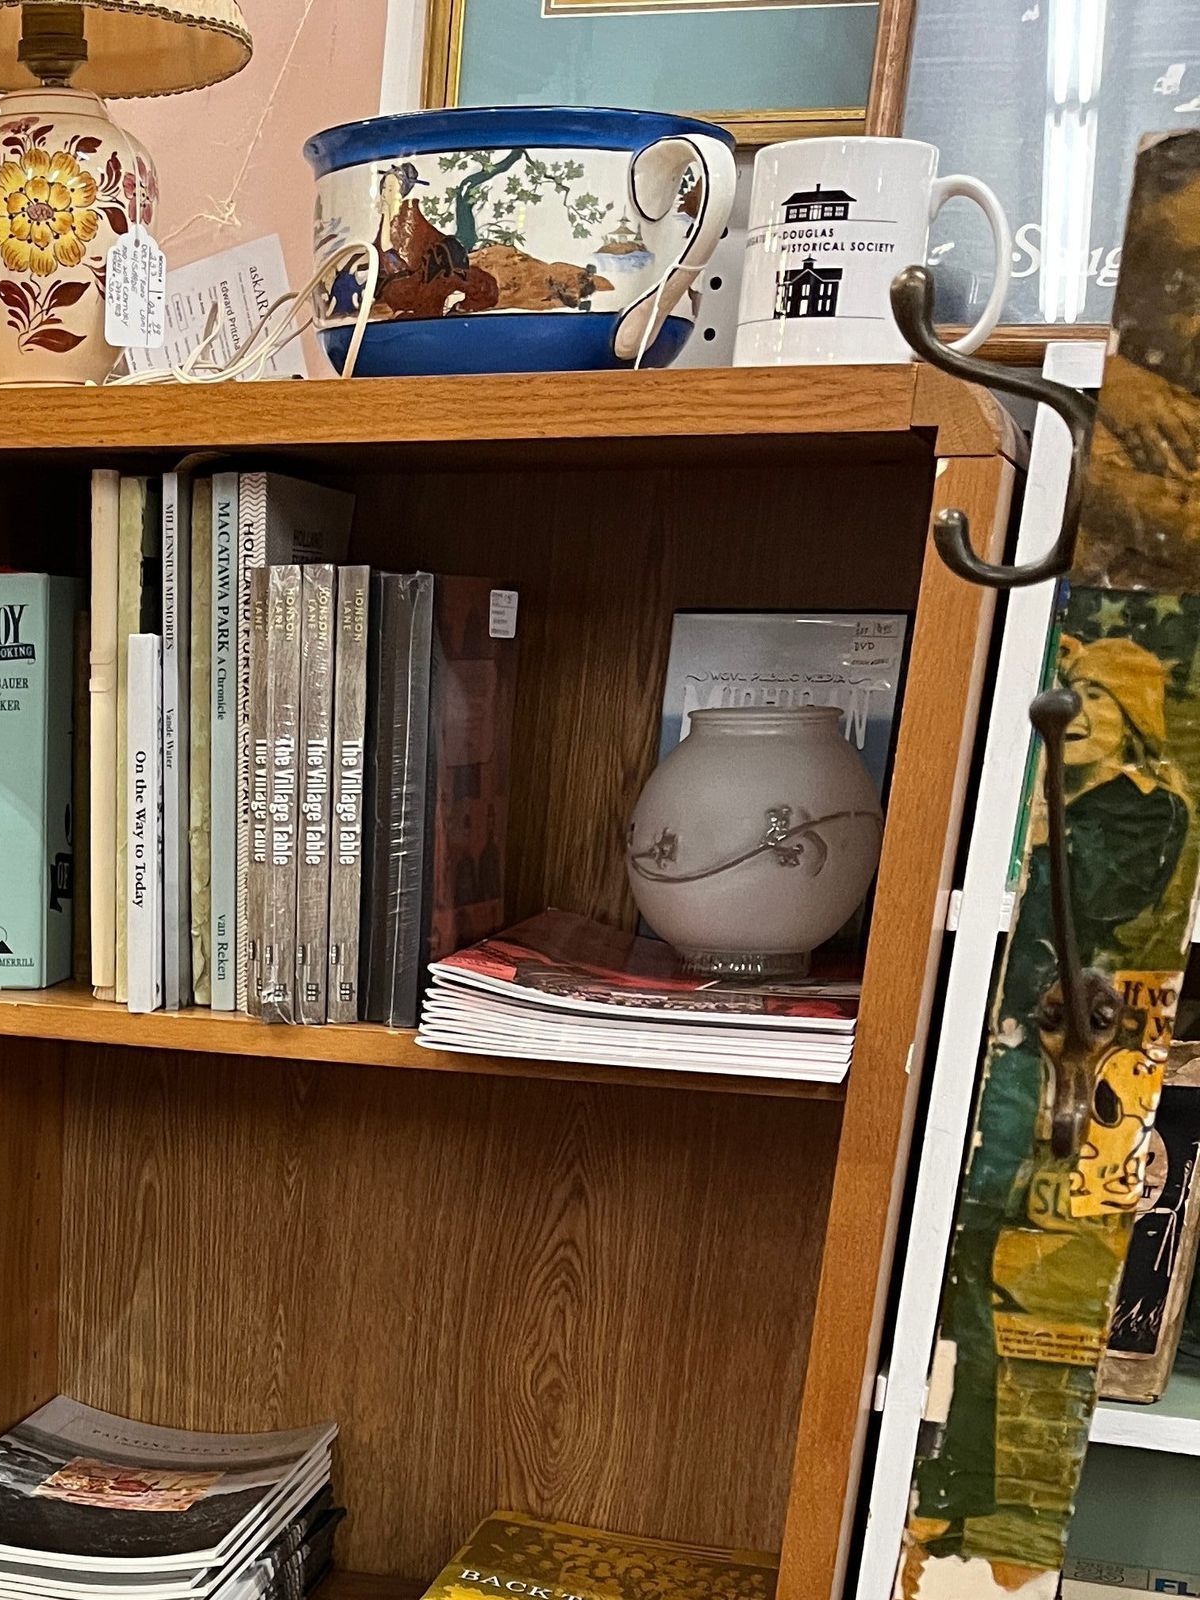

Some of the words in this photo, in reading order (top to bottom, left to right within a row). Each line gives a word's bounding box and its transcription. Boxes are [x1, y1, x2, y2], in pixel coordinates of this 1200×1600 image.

[781, 242, 846, 254] HISTORICAL
[850, 242, 895, 253] SOCIETY
[220, 280, 233, 316] Edward
[165, 503, 175, 583] MILLENNIUM
[217, 502, 230, 602] MACATAWA
[165, 582, 175, 651] MEMORIES
[216, 604, 230, 652] PARK
[308, 599, 316, 630] LANE
[343, 600, 352, 632] LANE
[854, 642, 875, 651] DVD
[216, 667, 226, 721] Chronicle
[134, 750, 147, 774] On
[274, 736, 294, 767] The
[307, 737, 328, 767] The
[342, 738, 363, 767] The
[136, 779, 147, 804] the
[269, 769, 294, 823] Village
[302, 768, 327, 823] Village
[336, 769, 362, 823] Village
[134, 807, 147, 844] Way
[136, 842, 145, 859] to
[272, 824, 293, 866] Table
[305, 824, 326, 866] Table
[339, 824, 360, 866] Table
[131, 862, 147, 910] Today
[217, 913, 226, 937] van
[217, 942, 229, 981] Reken
[1120, 981, 1143, 1007] If
[458, 1568, 554, 1600] BACK
